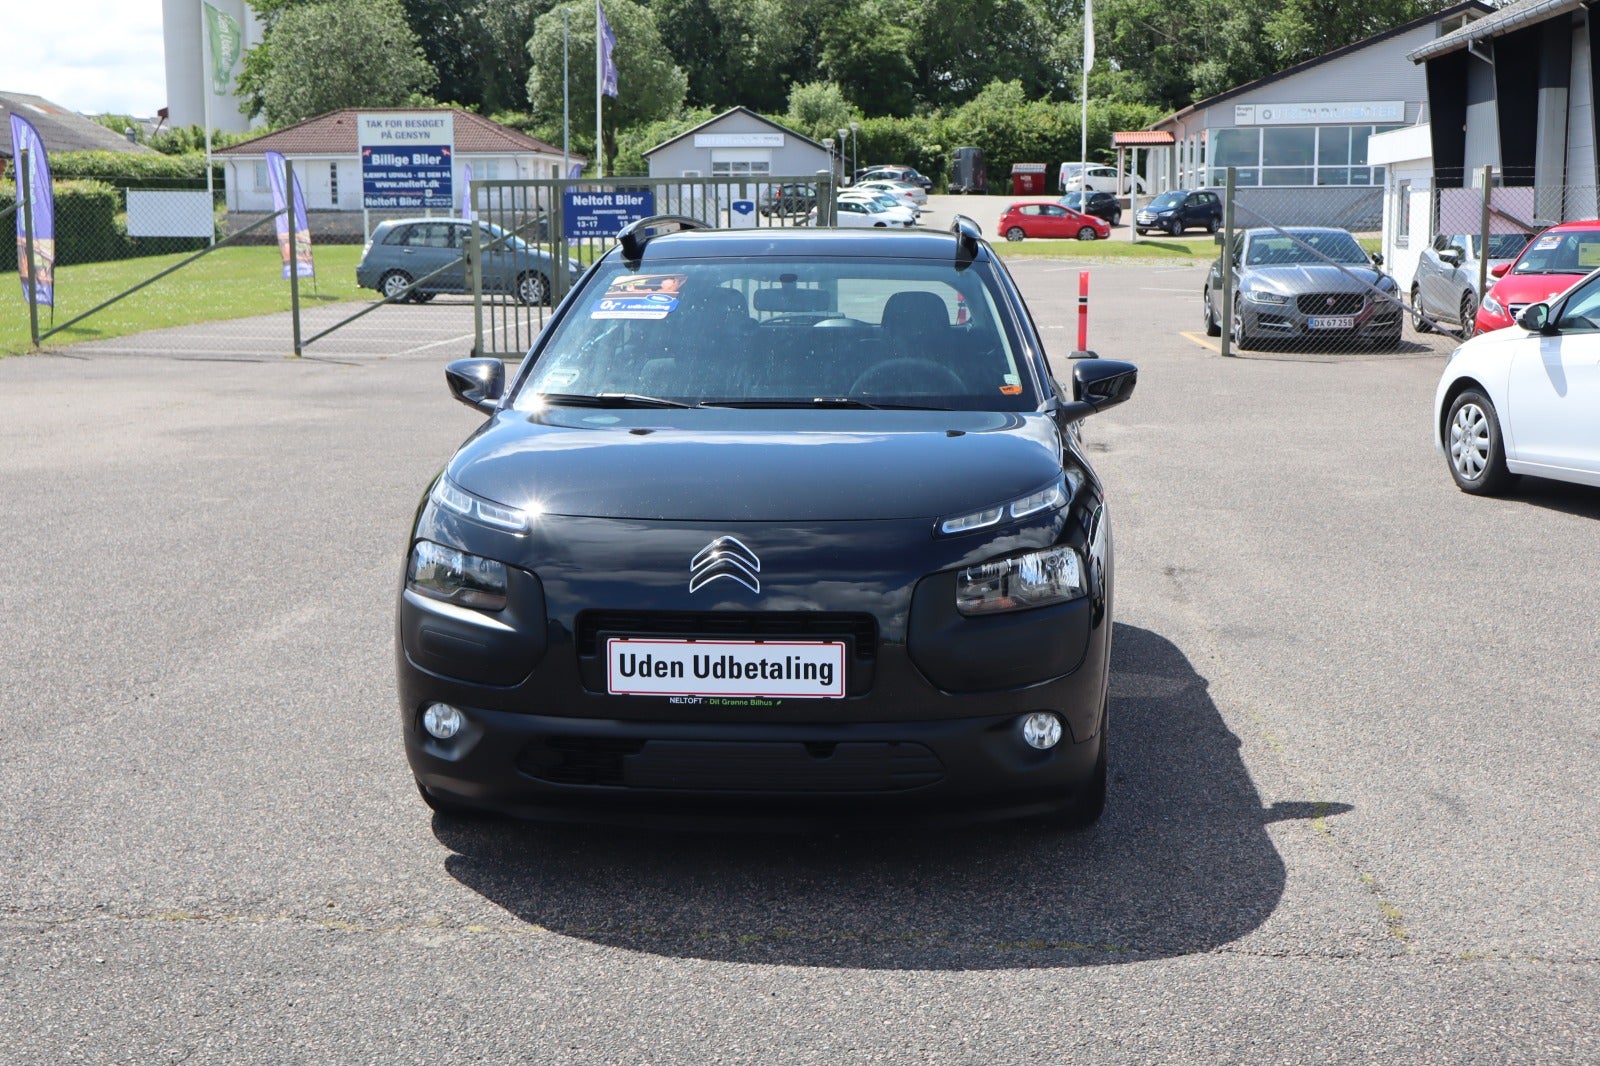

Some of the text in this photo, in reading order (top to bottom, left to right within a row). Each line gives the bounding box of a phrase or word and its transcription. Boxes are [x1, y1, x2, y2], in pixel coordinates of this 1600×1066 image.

[366, 119, 445, 128] TAK FOR BESØGET
[381, 130, 430, 139] PÅ GENSYN
[371, 153, 441, 167] Billige Biler
[375, 180, 440, 189] www.neltoft.dk
[365, 196, 422, 206] Neltoft Biler
[572, 194, 644, 206] Neltoft Biler
[1314, 319, 1325, 327] DX
[1326, 319, 1336, 327] 67
[619, 652, 834, 686] Uden Udbetaling
[669, 696, 703, 705] NELTOFT
[709, 698, 720, 706] Dit
[721, 698, 748, 706] Grønne
[750, 698, 773, 707] Bilhus
